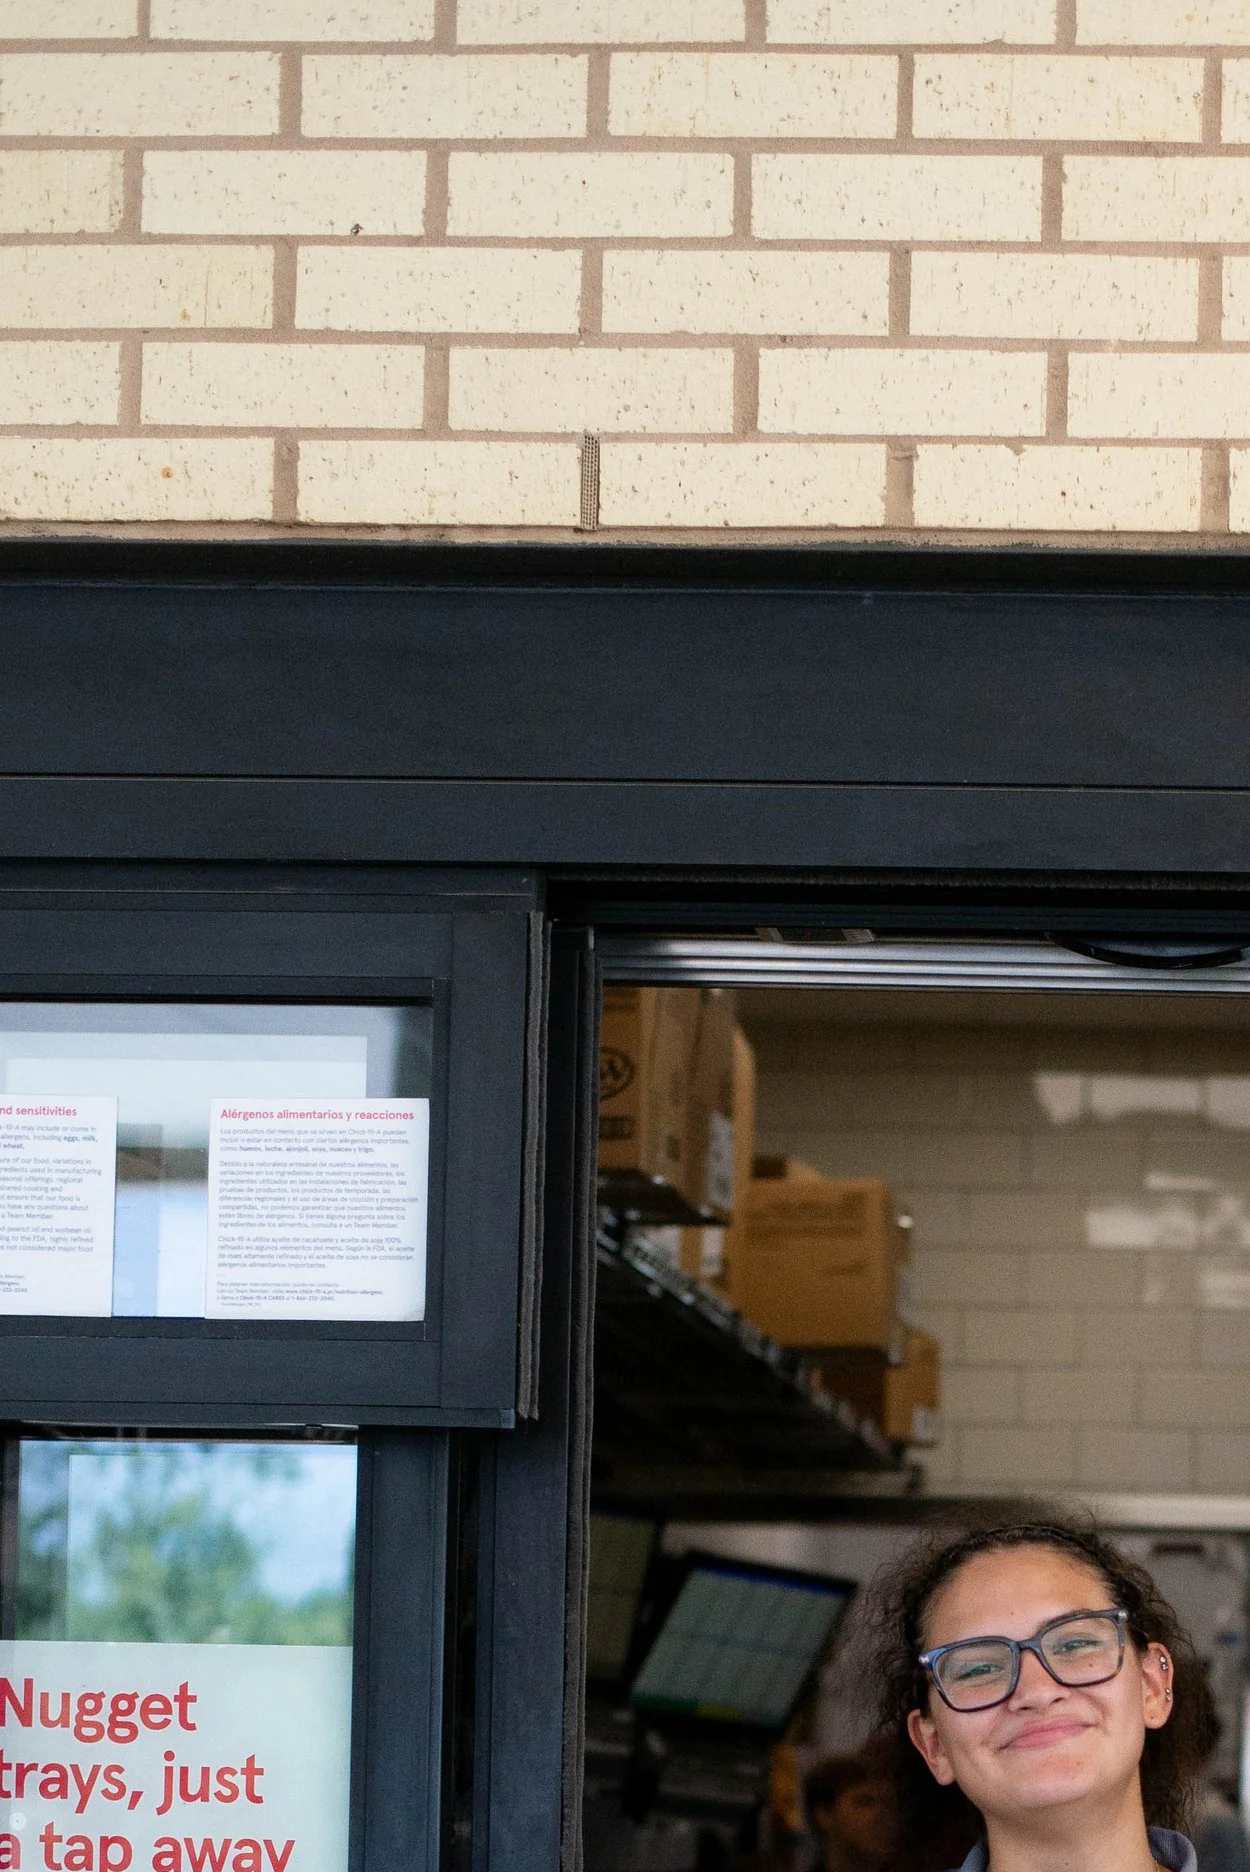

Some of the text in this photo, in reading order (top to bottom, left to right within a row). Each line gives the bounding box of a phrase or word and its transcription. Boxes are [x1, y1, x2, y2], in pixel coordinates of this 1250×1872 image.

[0, 1106, 77, 1116] nd sensitivities
[220, 1109, 414, 1121] Alérgenos alimentarios y reacciones
[0, 1677, 198, 1744] Nugget
[0, 1749, 264, 1816] trays, just
[0, 1832, 21, 1870] a
